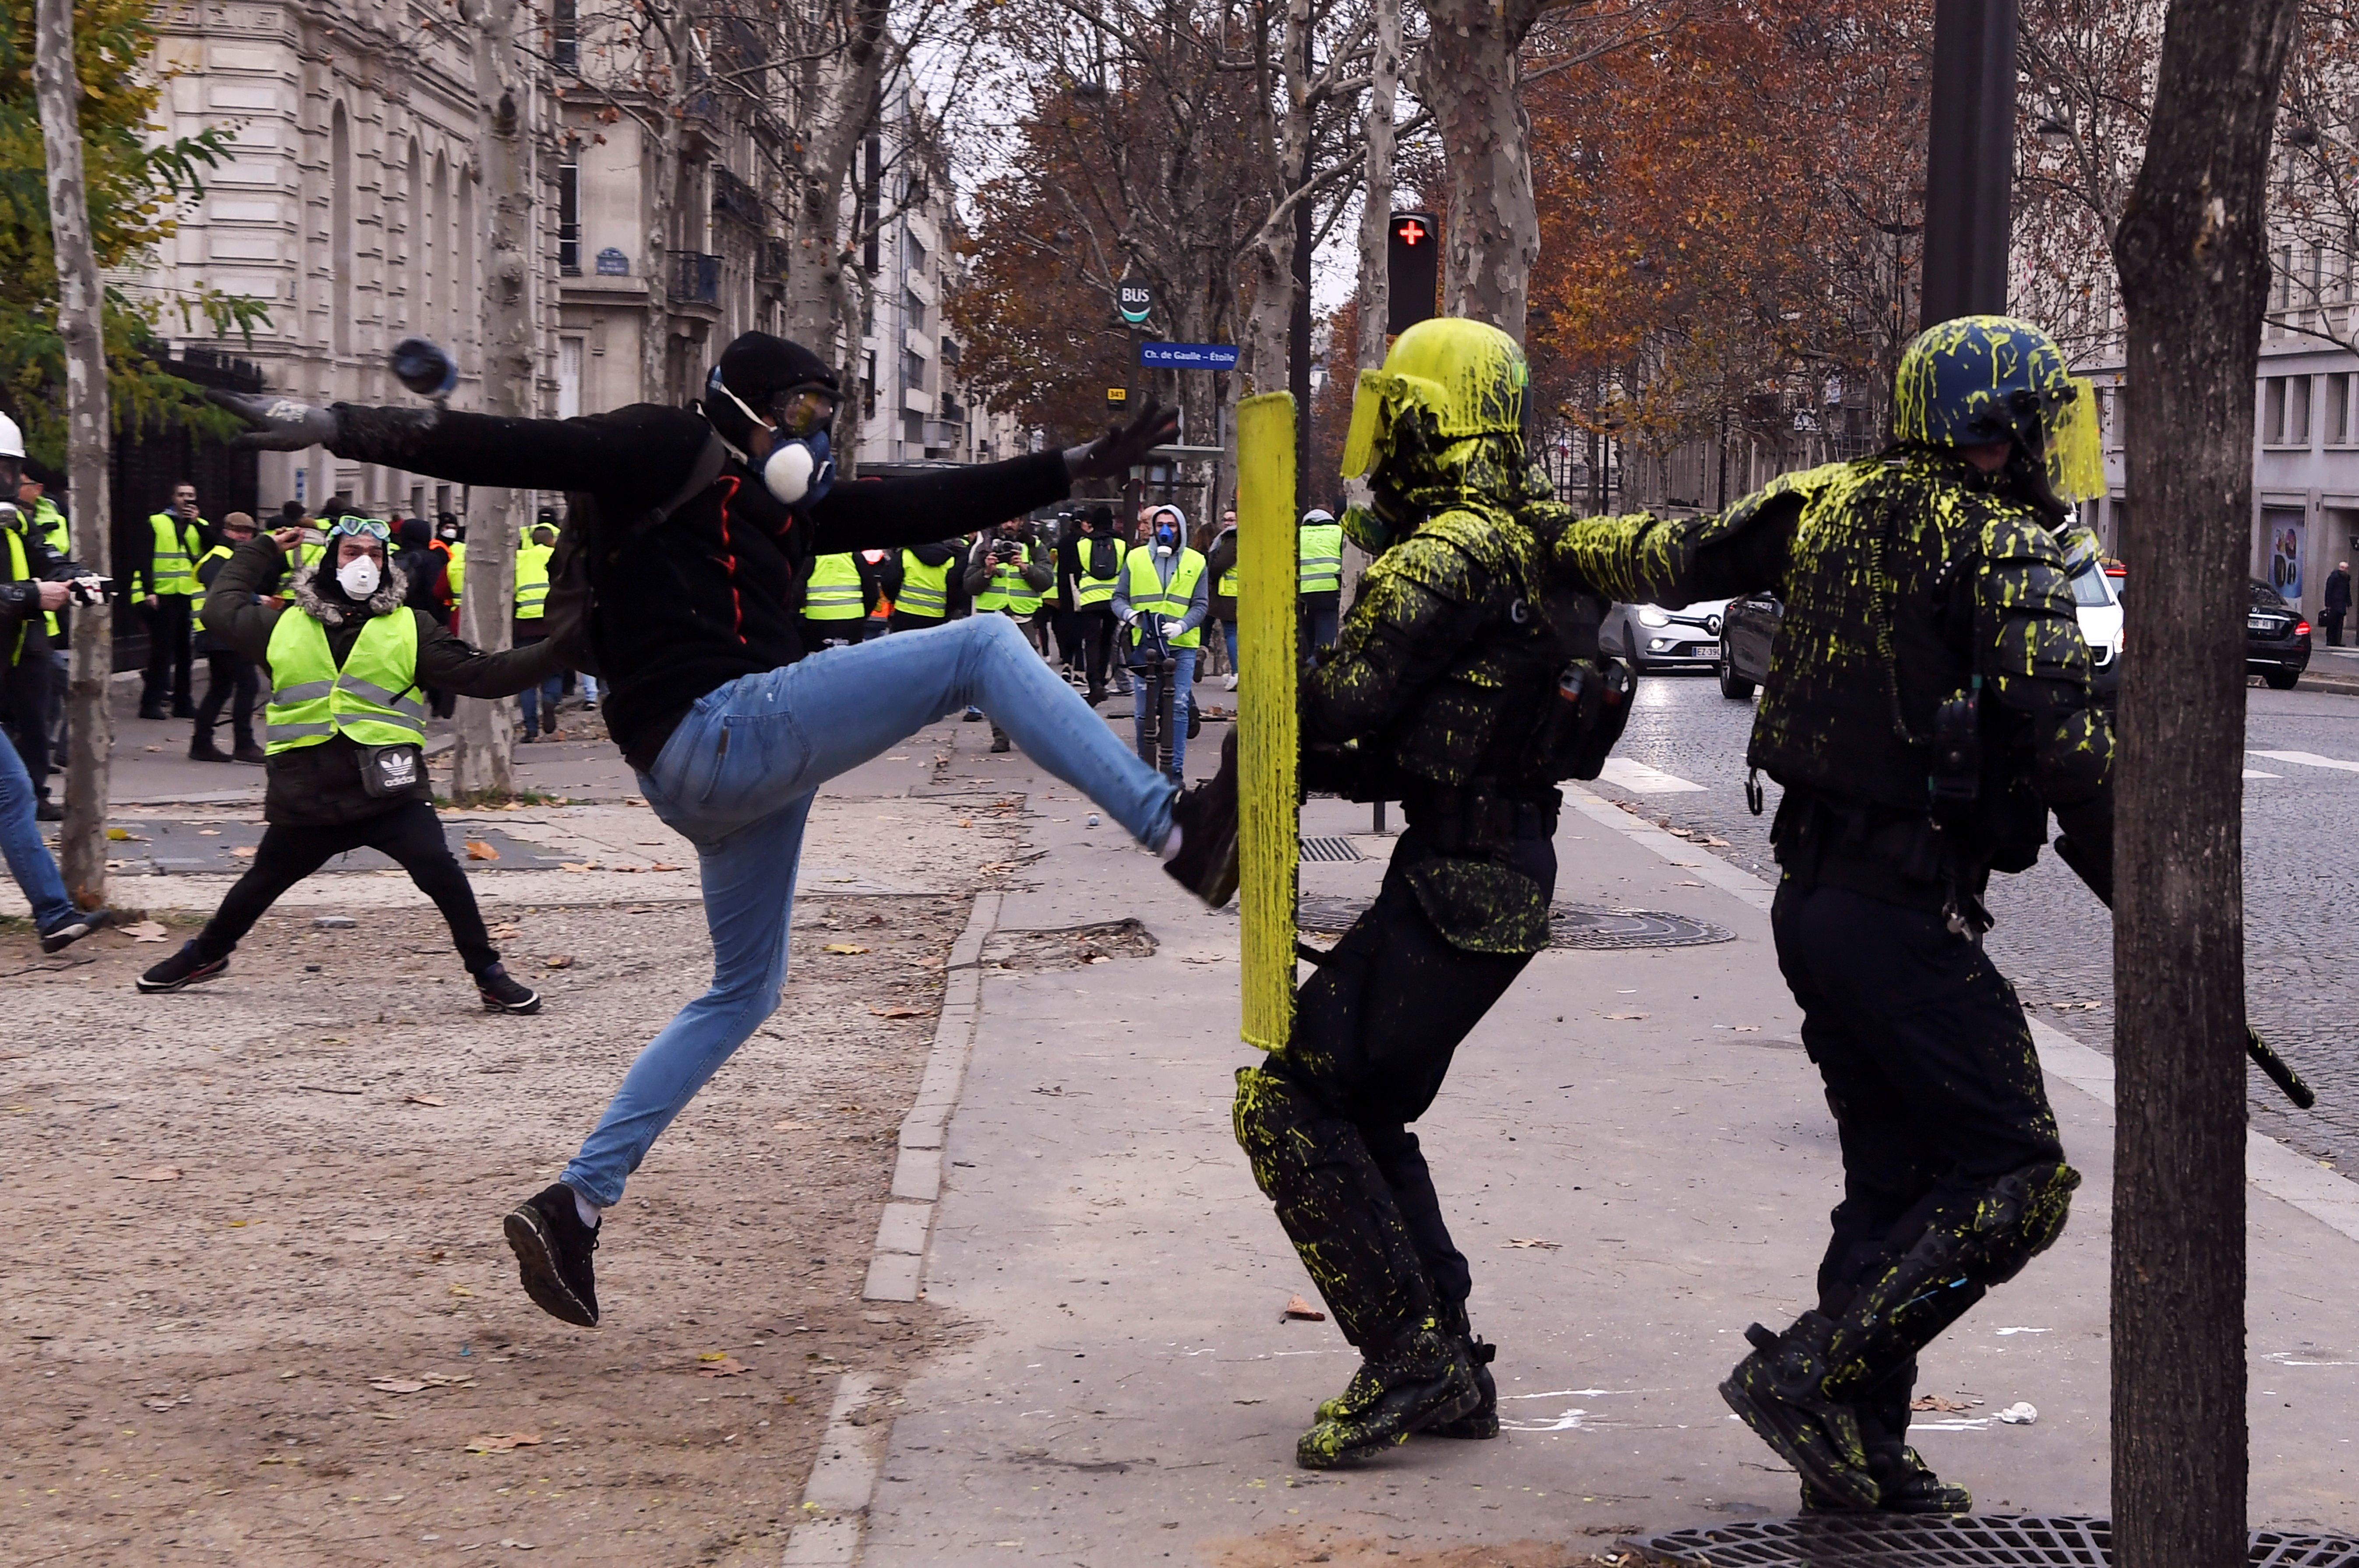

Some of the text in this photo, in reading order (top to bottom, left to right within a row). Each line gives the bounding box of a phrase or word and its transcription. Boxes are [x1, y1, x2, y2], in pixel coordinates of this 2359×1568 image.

[1122, 287, 1150, 303] BUS
[1144, 350, 1159, 358] Ch.
[1160, 351, 1172, 359] de
[1174, 351, 1201, 360] Gaulle
[1210, 351, 1235, 362] Étoile
[1511, 598, 1529, 623] G
